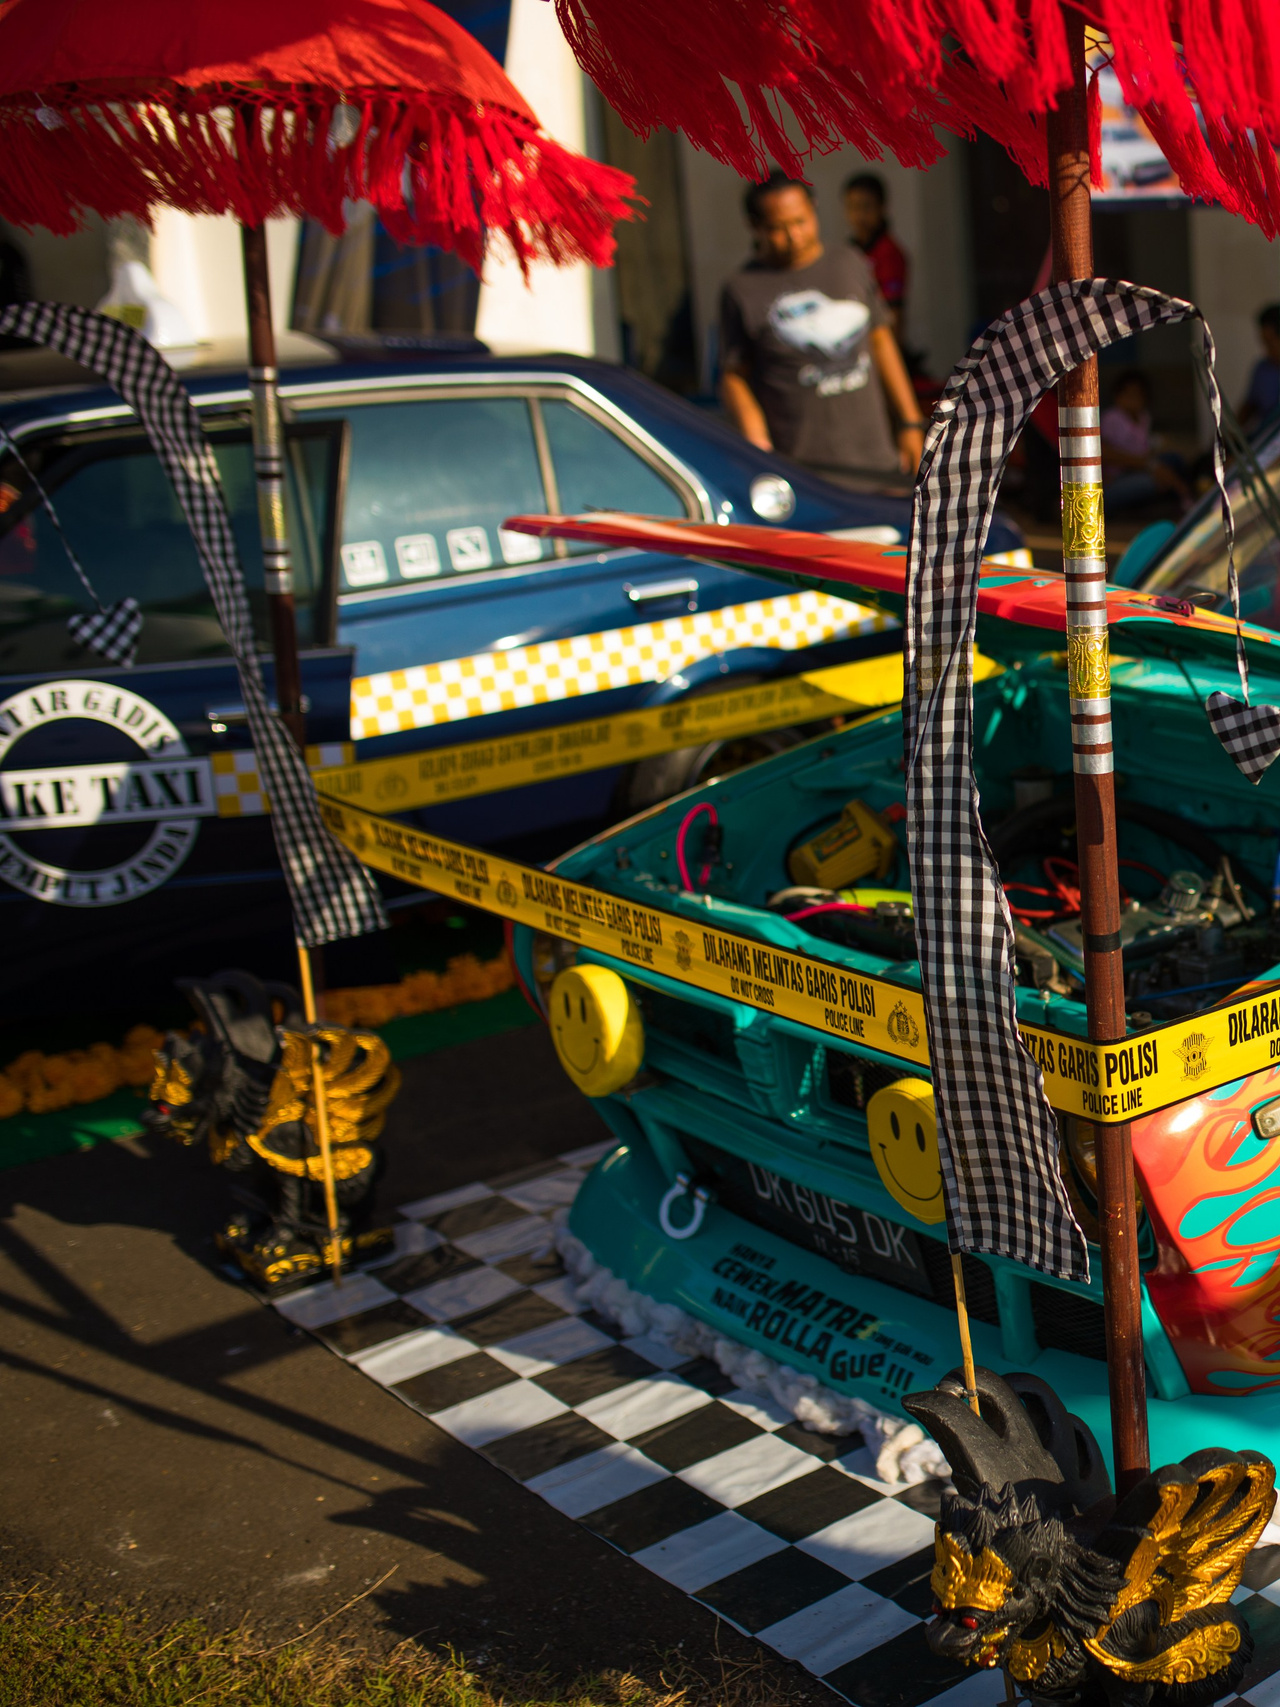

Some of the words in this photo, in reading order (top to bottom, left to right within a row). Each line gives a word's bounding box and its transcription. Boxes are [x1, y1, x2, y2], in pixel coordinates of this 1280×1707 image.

[83, 689, 176, 755] GADIS
[90, 769, 204, 813] TAXI
[0, 843, 102, 899] EMPUT
[111, 825, 190, 898] JANDA
[521, 873, 563, 912] DILARANG
[562, 886, 605, 927] MELINTAS
[605, 901, 633, 936] GARIS
[632, 909, 664, 946] POLISI
[621, 938, 641, 960] POLICE
[641, 944, 654, 964] LINE
[703, 932, 752, 976] DILARANG
[751, 947, 804, 995] MELINTAS
[805, 965, 839, 1006] GARIS
[839, 978, 876, 1018] POLISI
[730, 976, 739, 993] DO
[740, 979, 753, 998] NOT
[753, 983, 775, 1008] CROSS
[824, 1008, 849, 1033] POLICE
[849, 1015, 865, 1039] LINE
[1269, 1039, 1280, 1059] DO
[1058, 1042, 1099, 1088] GARIS
[1105, 1039, 1159, 1088] POLISI
[1082, 1090, 1119, 1116] POLICE
[1121, 1086, 1143, 1114] LINE
[747, 1161, 794, 1213] DK
[861, 1209, 917, 1269] DK
[713, 1257, 780, 1298] CEWEK
[771, 1279, 880, 1340] MATRE
[713, 1287, 754, 1319] NAIK
[746, 1301, 834, 1364] ROLLA
